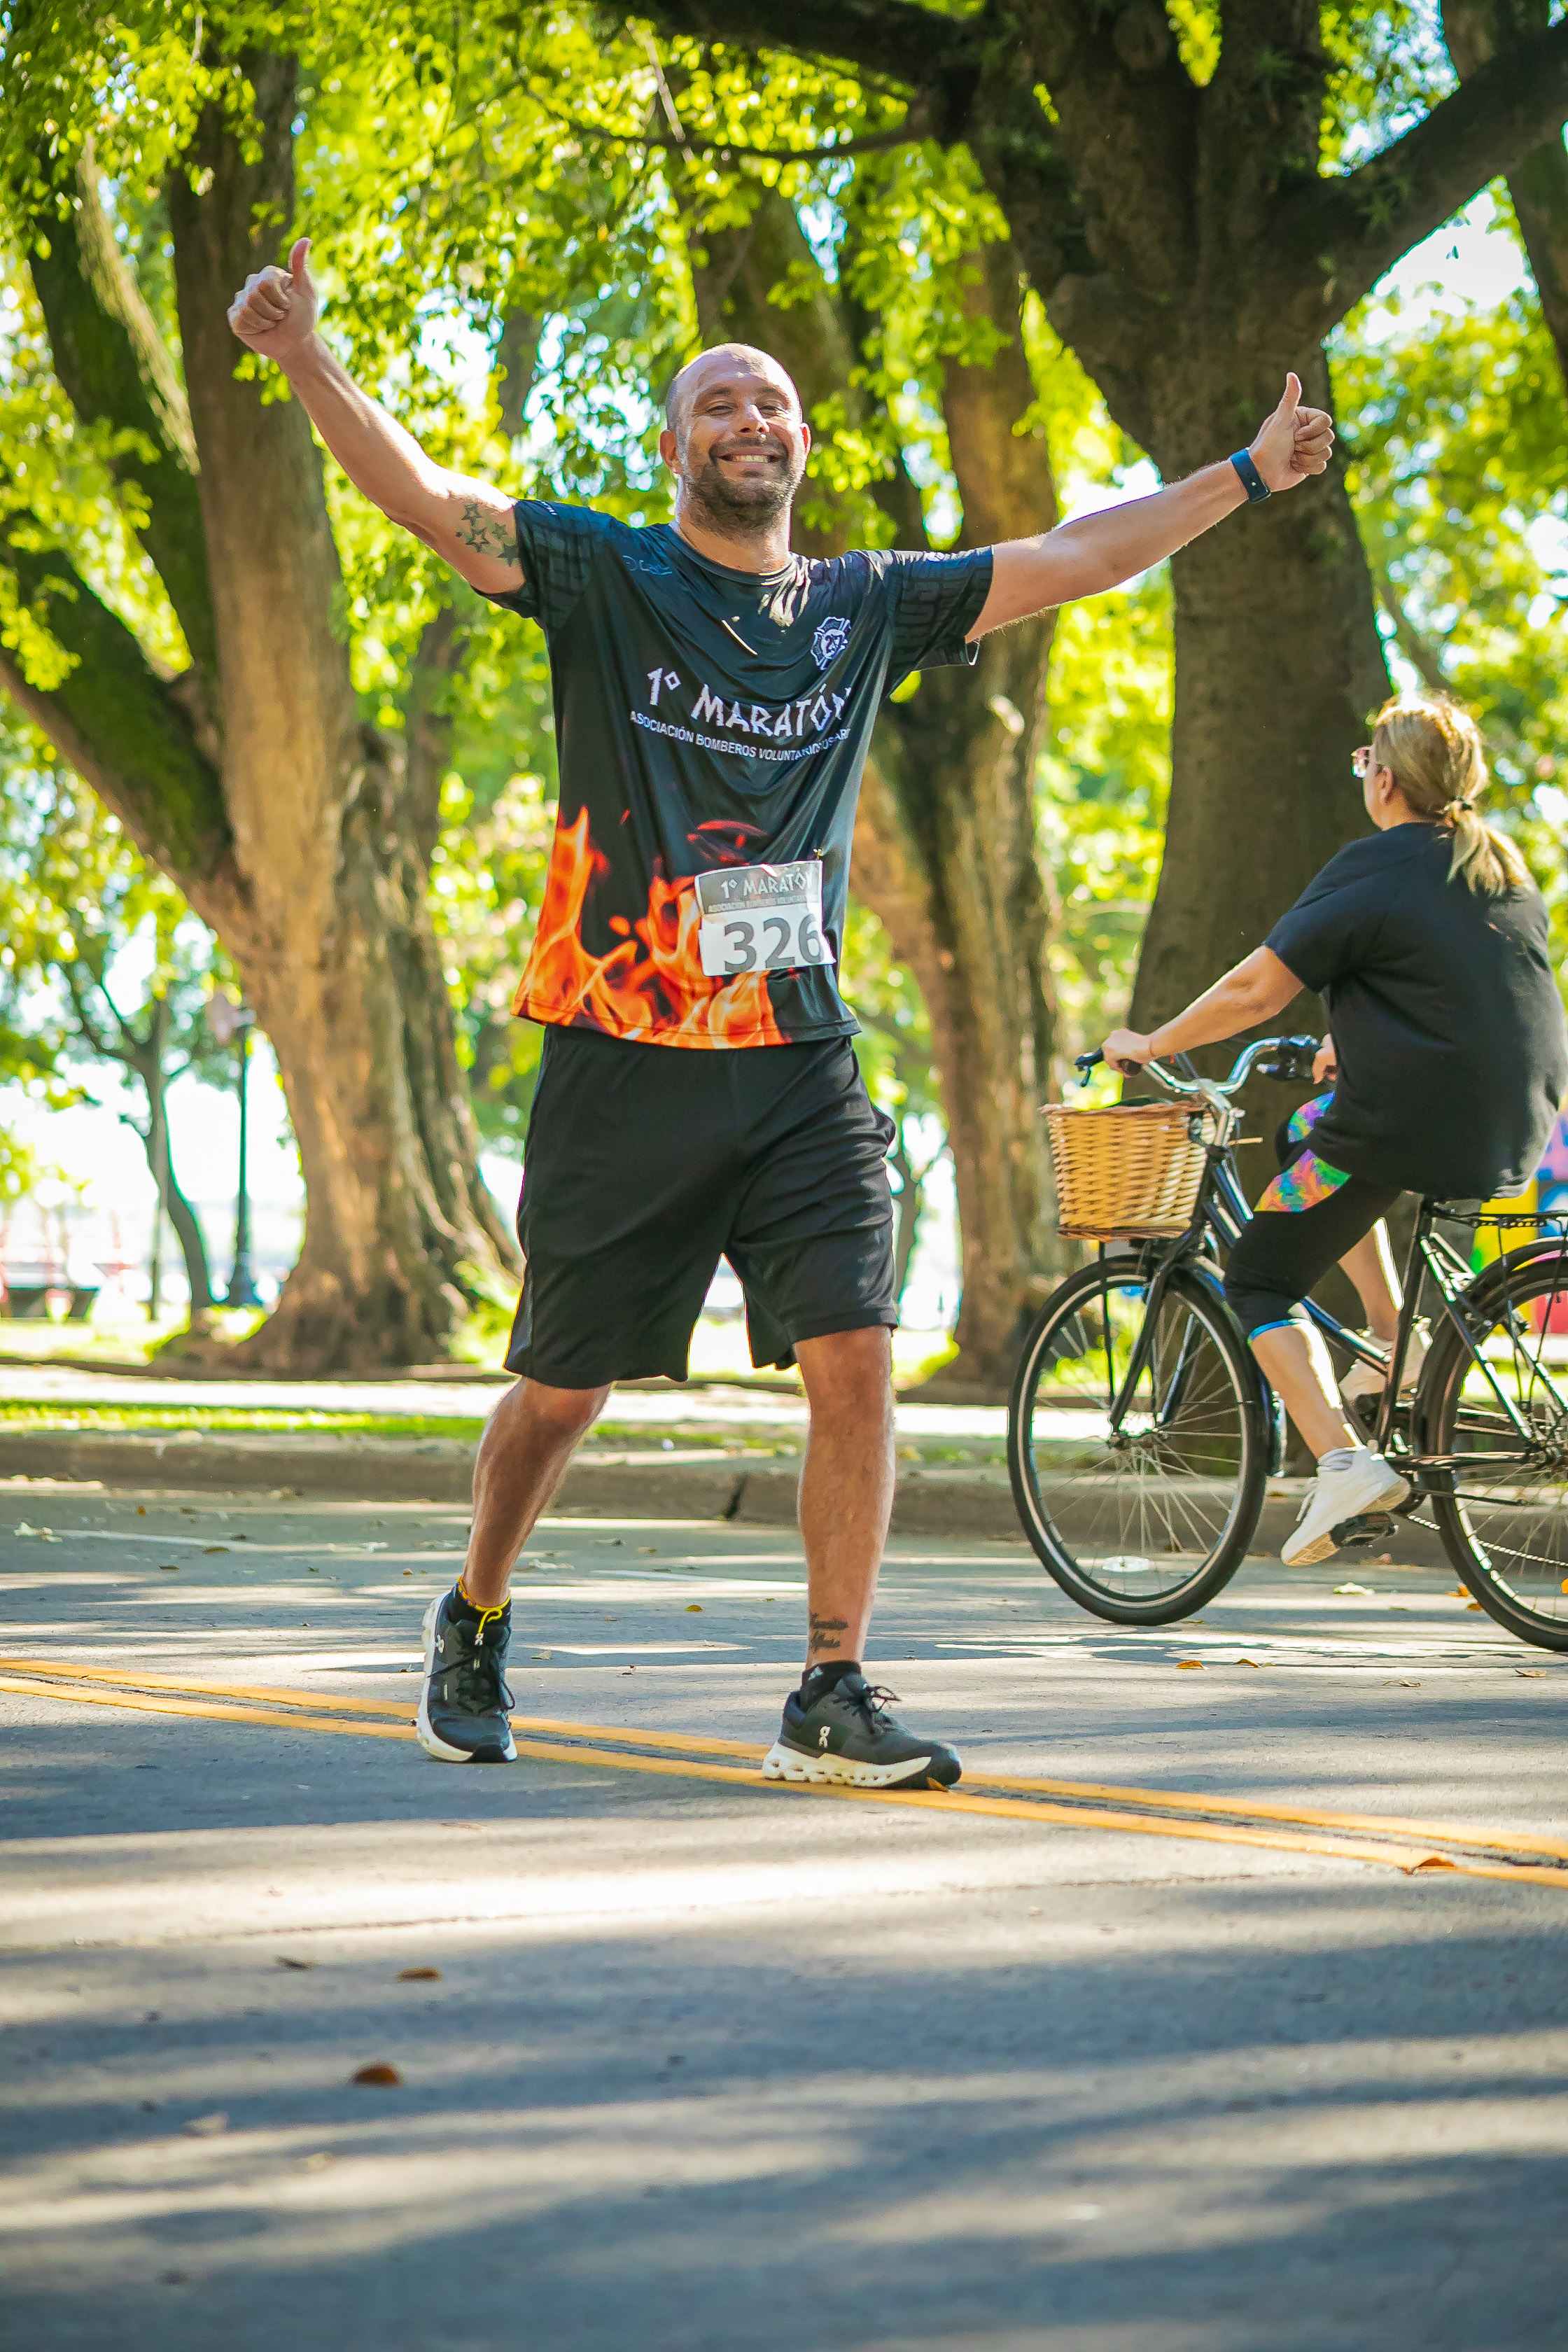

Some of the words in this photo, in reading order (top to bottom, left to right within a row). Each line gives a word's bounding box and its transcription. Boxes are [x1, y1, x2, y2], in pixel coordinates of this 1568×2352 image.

[630, 710, 694, 743] ASOCIACIÓN
[696, 734, 757, 758] BOMBEROS
[724, 913, 825, 974] 326
